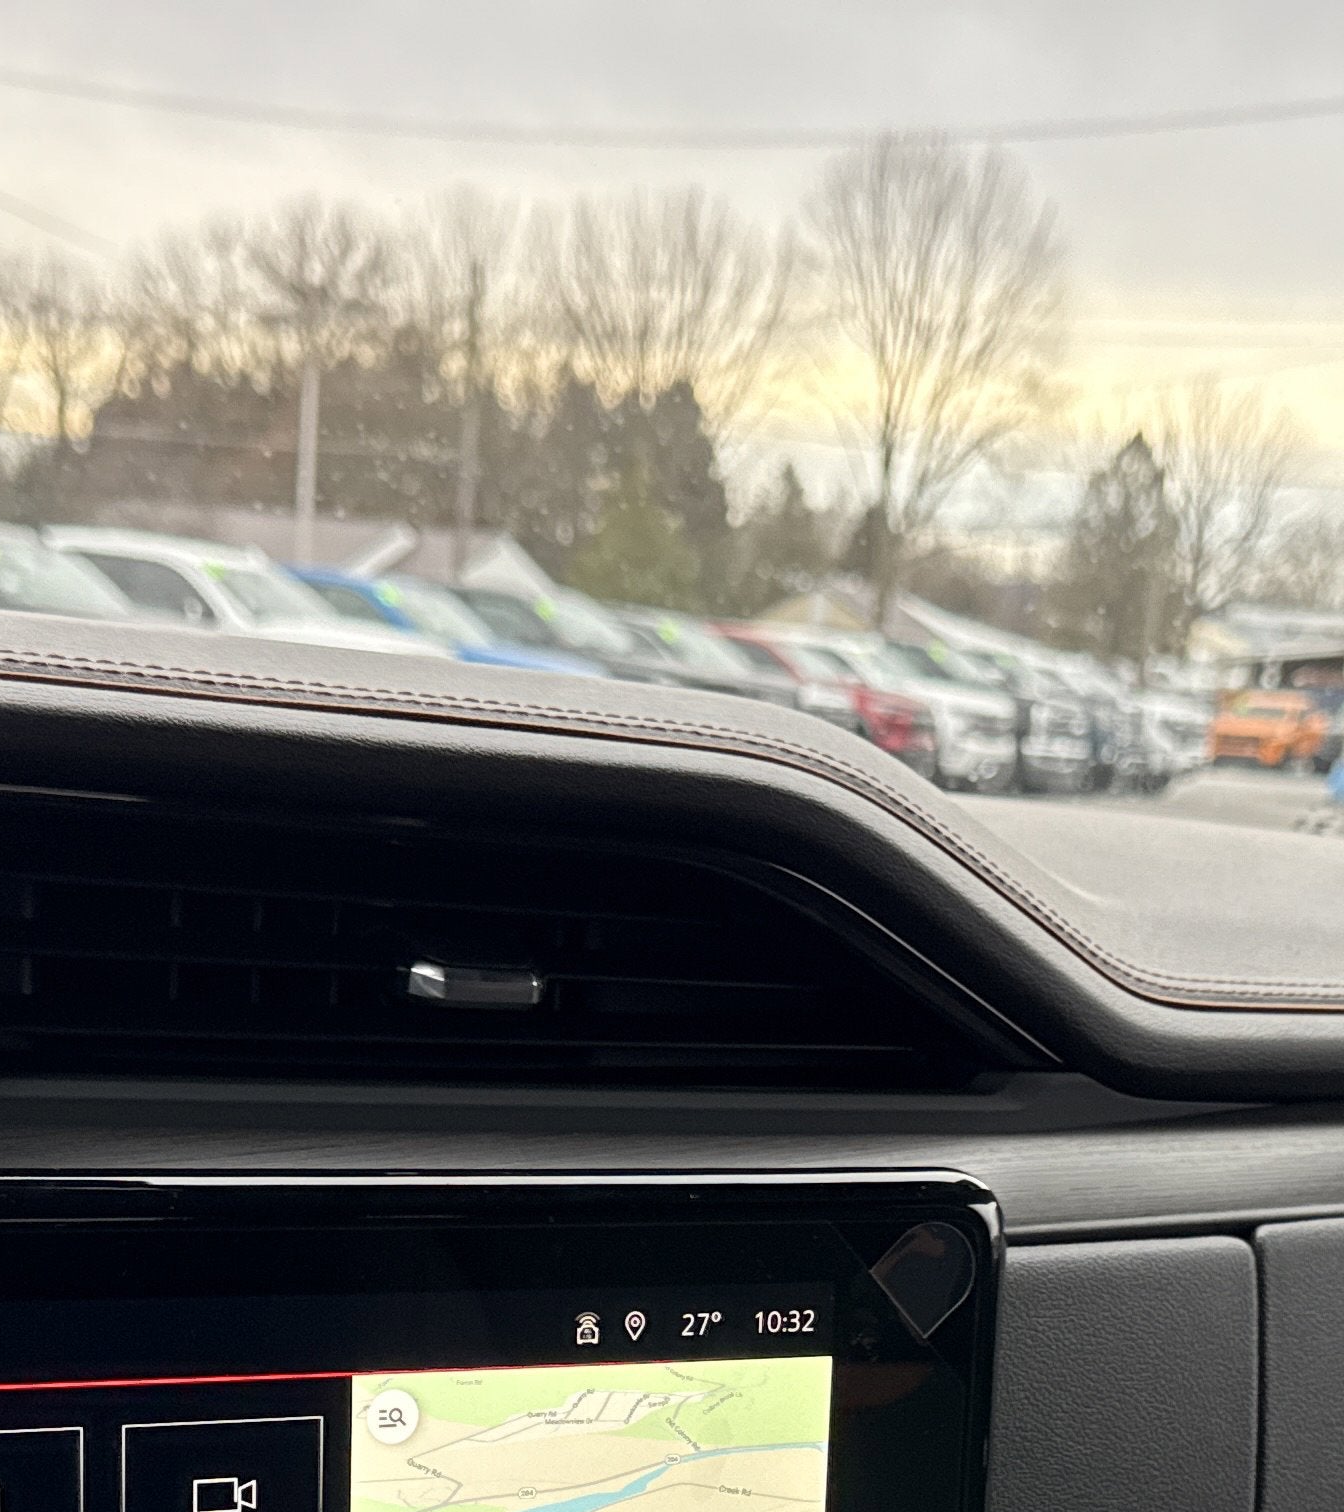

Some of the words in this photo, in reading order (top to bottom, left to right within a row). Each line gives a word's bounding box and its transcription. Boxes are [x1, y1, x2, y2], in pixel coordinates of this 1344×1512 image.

[681, 1311, 722, 1337] 27°
[755, 1309, 816, 1334] 10:32
[407, 1457, 431, 1476] Quarry
[431, 1467, 442, 1478] Rd
[719, 1485, 740, 1495] Creek
[740, 1488, 752, 1496] Rd
